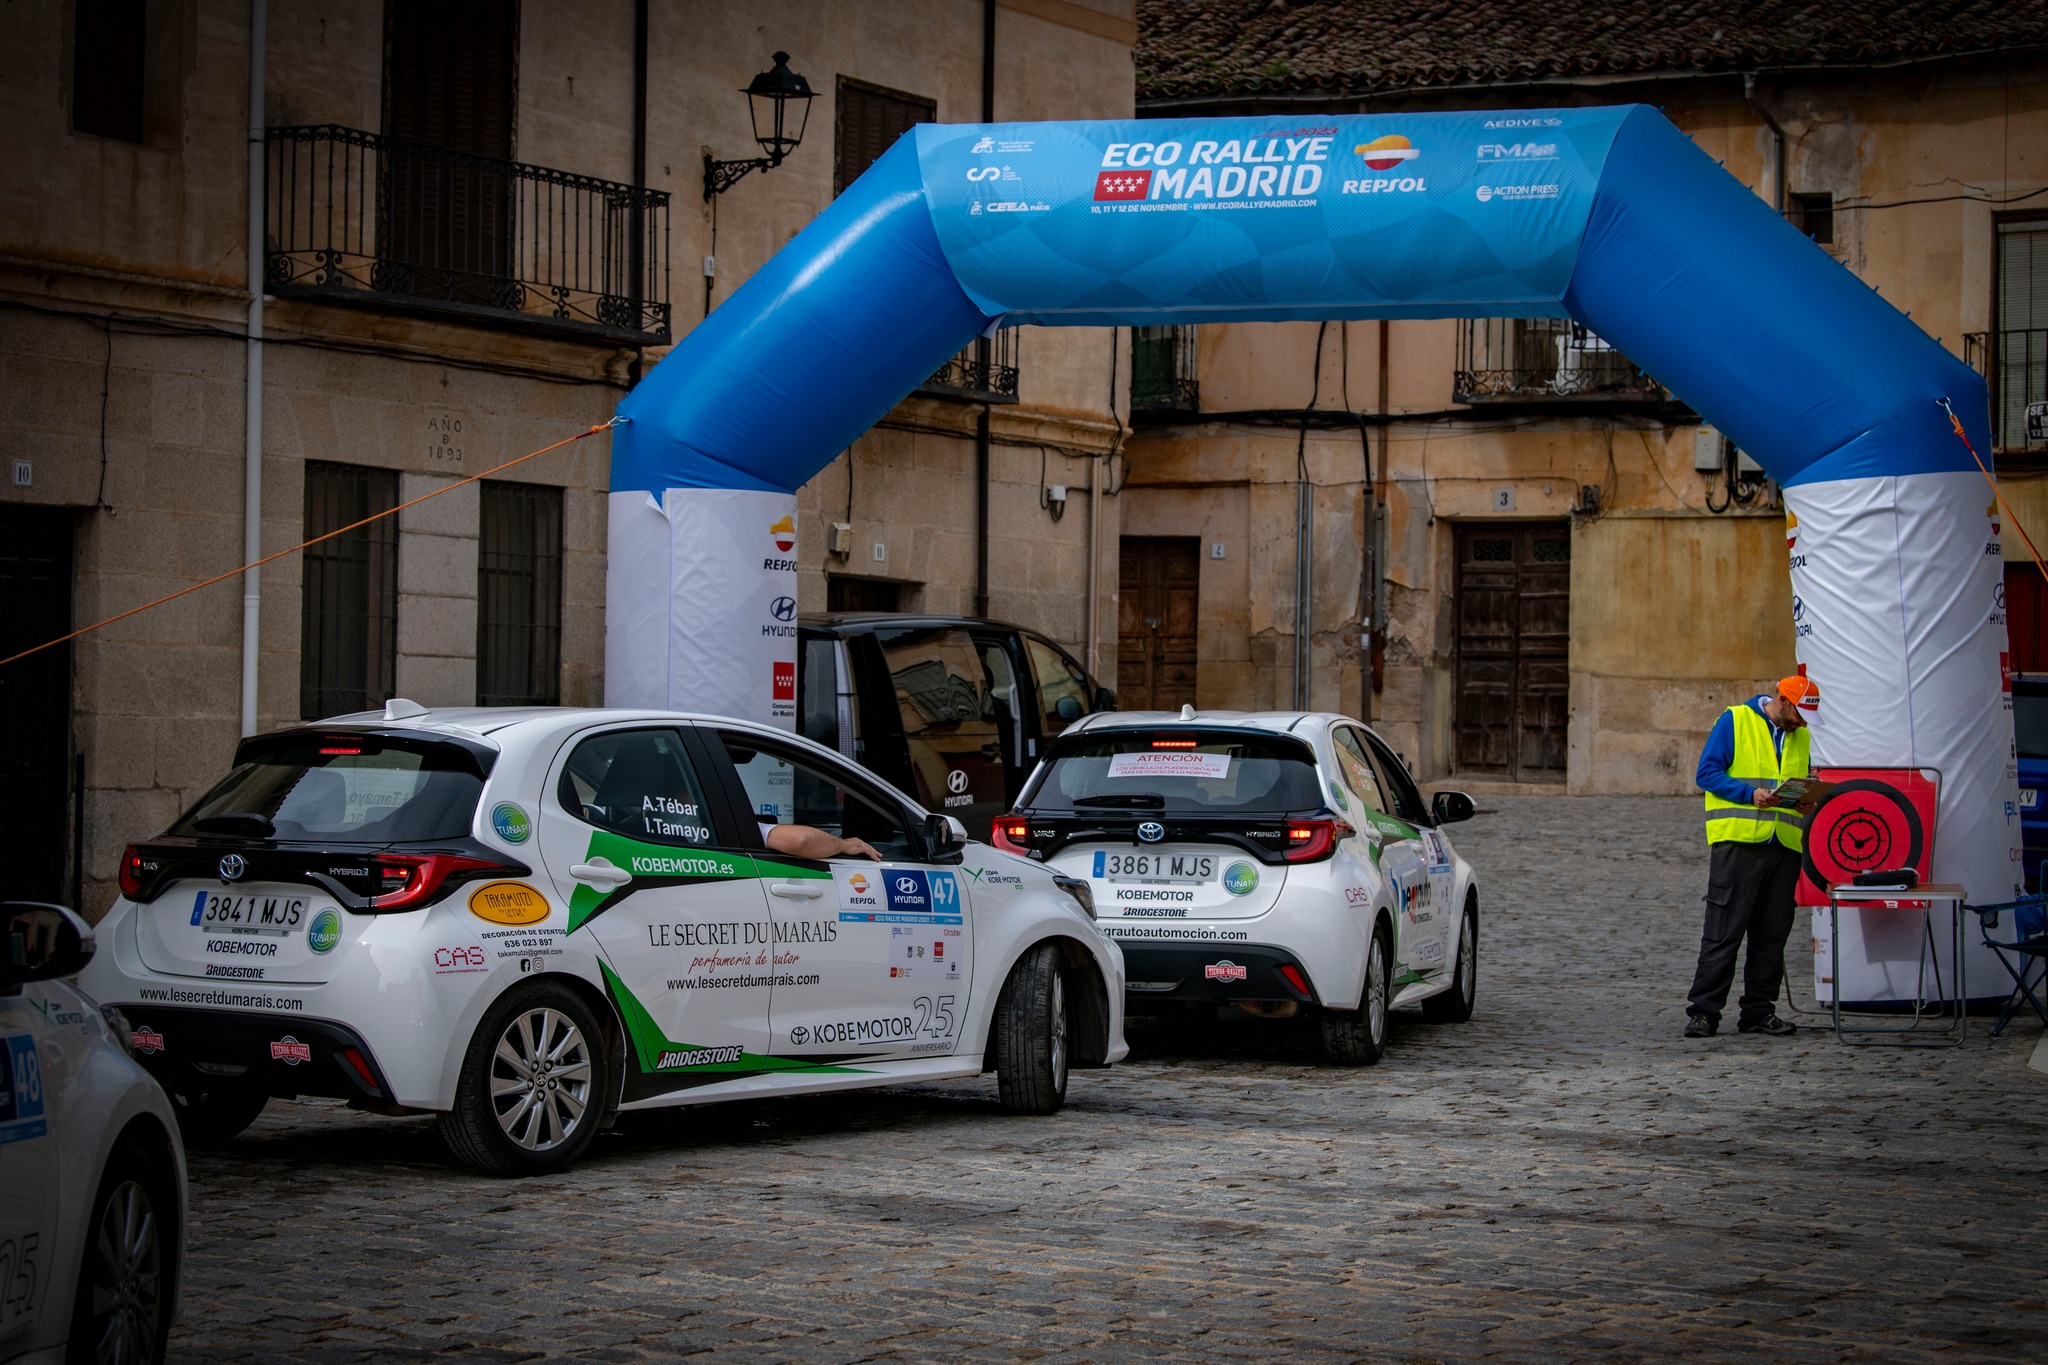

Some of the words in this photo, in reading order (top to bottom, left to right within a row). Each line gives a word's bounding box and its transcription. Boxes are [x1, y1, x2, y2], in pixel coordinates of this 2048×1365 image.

[1293, 126, 1338, 137] 2023
[1484, 119, 1541, 128] AEDIVE
[1101, 142, 1182, 167] ECO
[1188, 137, 1334, 165] RALLYE
[1151, 164, 1322, 200] MADRID
[1342, 178, 1426, 194] REPSOL
[1493, 186, 1529, 196] ACTION
[1531, 184, 1559, 194] PRESS
[1119, 205, 1127, 213] 12
[1140, 203, 1188, 212] NOVIEMBRE
[1193, 200, 1317, 210] WWW.ECORALLYEMADRID.COM
[428, 415, 462, 432] AÑO
[430, 446, 462, 461] 1893
[18, 466, 29, 482] 10
[1501, 492, 1508, 506] 3
[1137, 753, 1203, 763] ATENCIÓN
[642, 795, 698, 816] A.Tébar
[944, 794, 974, 808] HYUNDAI
[497, 824, 528, 835] TUNAP
[645, 817, 710, 842] I.Tamayo
[329, 867, 363, 877] HYBRID
[632, 857, 735, 875] KOBEMOTOR.es
[1109, 855, 1161, 876] 3861
[1170, 857, 1211, 877] MJS
[933, 878, 954, 905] 47
[1226, 880, 1254, 888] TUNAP
[850, 897, 876, 905] REPSOL
[894, 895, 924, 905] HYUNDAI
[1117, 889, 1193, 902] KOBEMOTOR
[1345, 887, 1368, 903] CAS
[206, 897, 255, 922] 3841
[261, 899, 302, 925] MJS
[1123, 907, 1187, 918] BRIDGESTONE
[310, 932, 336, 943] TUNAP
[481, 928, 527, 939] DECORACIÓN
[538, 928, 567, 936] EVENTOS
[648, 924, 670, 946] LE
[674, 923, 739, 946] SECRET
[743, 922, 769, 944] DU
[773, 920, 837, 943] MARAIS
[206, 940, 277, 956] KOBEMOTOR
[504, 939, 520, 948] 636
[522, 939, 537, 947] 023
[538, 938, 553, 946] 897
[434, 946, 485, 967] CAS
[755, 948, 768, 966] de
[773, 950, 800, 966] autor
[206, 964, 264, 979] BRIDGESTONE
[667, 973, 820, 991] www.lesecretdumarais.com
[140, 987, 303, 1011] www.lesecretdumarais.com
[914, 995, 954, 1038] 25
[814, 1017, 913, 1044] KOBEMOTOR
[910, 1041, 952, 1053] ANIVERSARIO
[656, 1045, 743, 1070] BRIDGESTONE
[17, 1049, 40, 1105] 48
